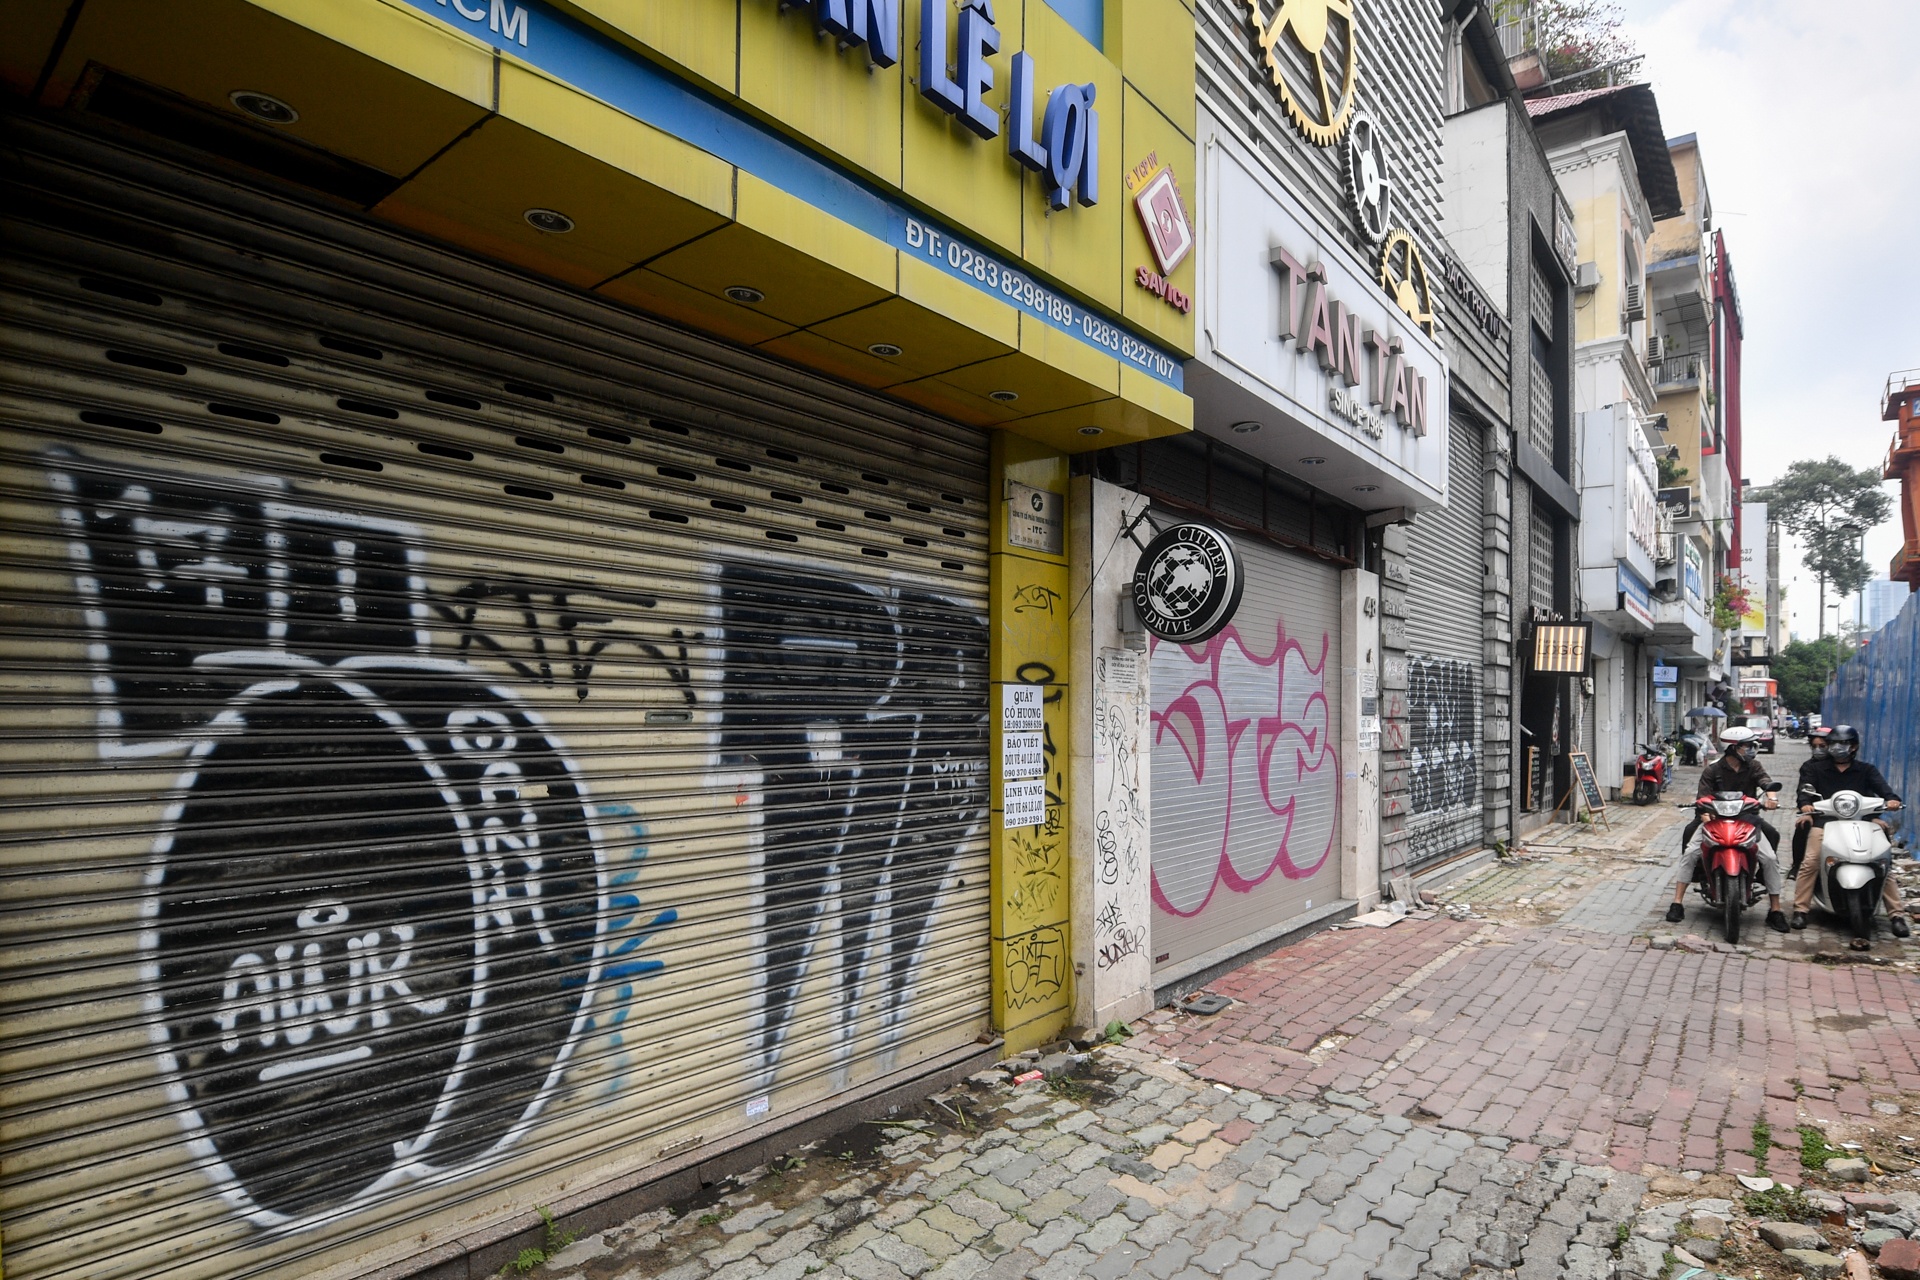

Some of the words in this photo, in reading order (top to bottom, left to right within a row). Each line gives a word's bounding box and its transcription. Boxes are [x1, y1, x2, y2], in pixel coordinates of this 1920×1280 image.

[919, 0, 1000, 140] LÊ
[1009, 50, 1098, 208] LỢI
[905, 217, 942, 258] ĐT:
[947, 242, 998, 288] 0283
[1001, 270, 1073, 326] 8298189
[1083, 315, 1119, 351] 0283
[1121, 336, 1175, 379] 8227107
[1136, 265, 1191, 314] SAVICO
[1270, 246, 1360, 387] TÂN
[1363, 330, 1428, 437] TÂN
[1329, 388, 1363, 426] SINCE
[1362, 410, 1384, 440] 1985
[1177, 527, 1226, 578] CITIZEN
[1134, 572, 1192, 634] ECO-DRIVE
[1363, 596, 1377, 618] 48
[1004, 769, 1016, 778] 090
[1016, 768, 1027, 776] 370
[1005, 786, 1023, 798] LINH
[1005, 818, 1016, 827] 090
